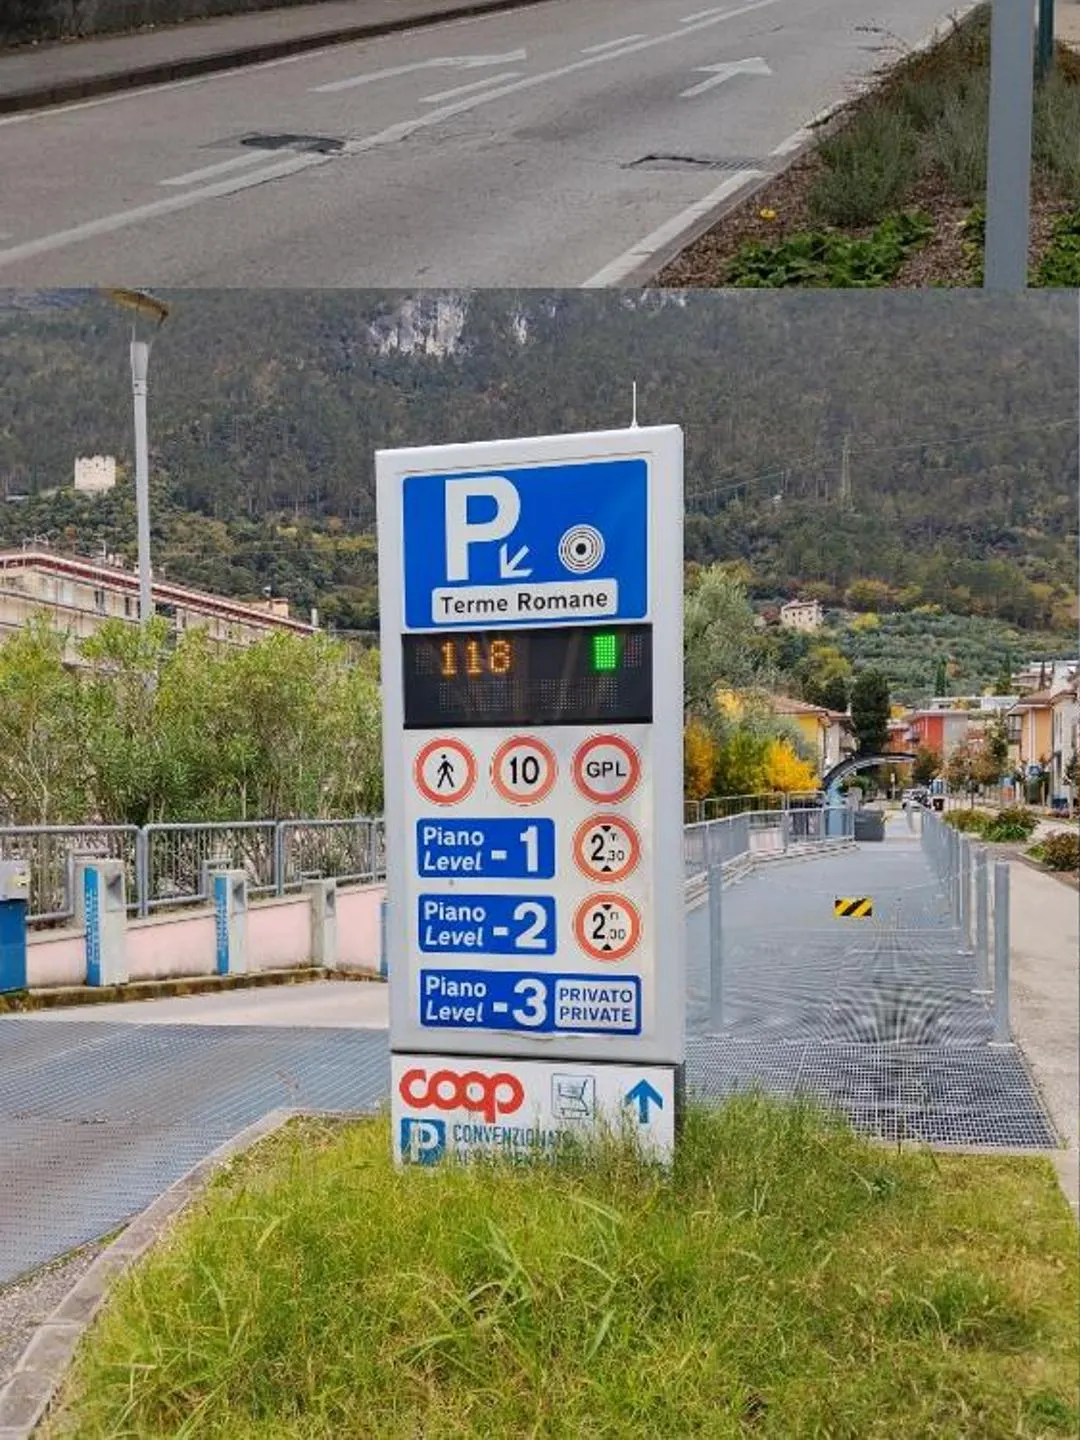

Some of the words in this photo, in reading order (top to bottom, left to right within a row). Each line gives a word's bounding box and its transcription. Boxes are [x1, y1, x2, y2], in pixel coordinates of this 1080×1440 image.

[445, 476, 521, 581] P
[441, 594, 508, 614] Terme
[517, 590, 608, 611] Romane
[441, 639, 512, 677] 118
[509, 756, 540, 785] 10
[586, 761, 627, 778] GPL
[423, 827, 484, 846] Piano
[424, 851, 482, 871] Level
[424, 901, 486, 922] Piano
[425, 926, 483, 947] Level
[425, 977, 487, 997] Piano
[559, 987, 633, 1004] PRIVATO
[426, 1002, 484, 1022] Level
[559, 1007, 632, 1022] PRIVATE
[400, 1069, 525, 1124] coop
[410, 1122, 439, 1162] P
